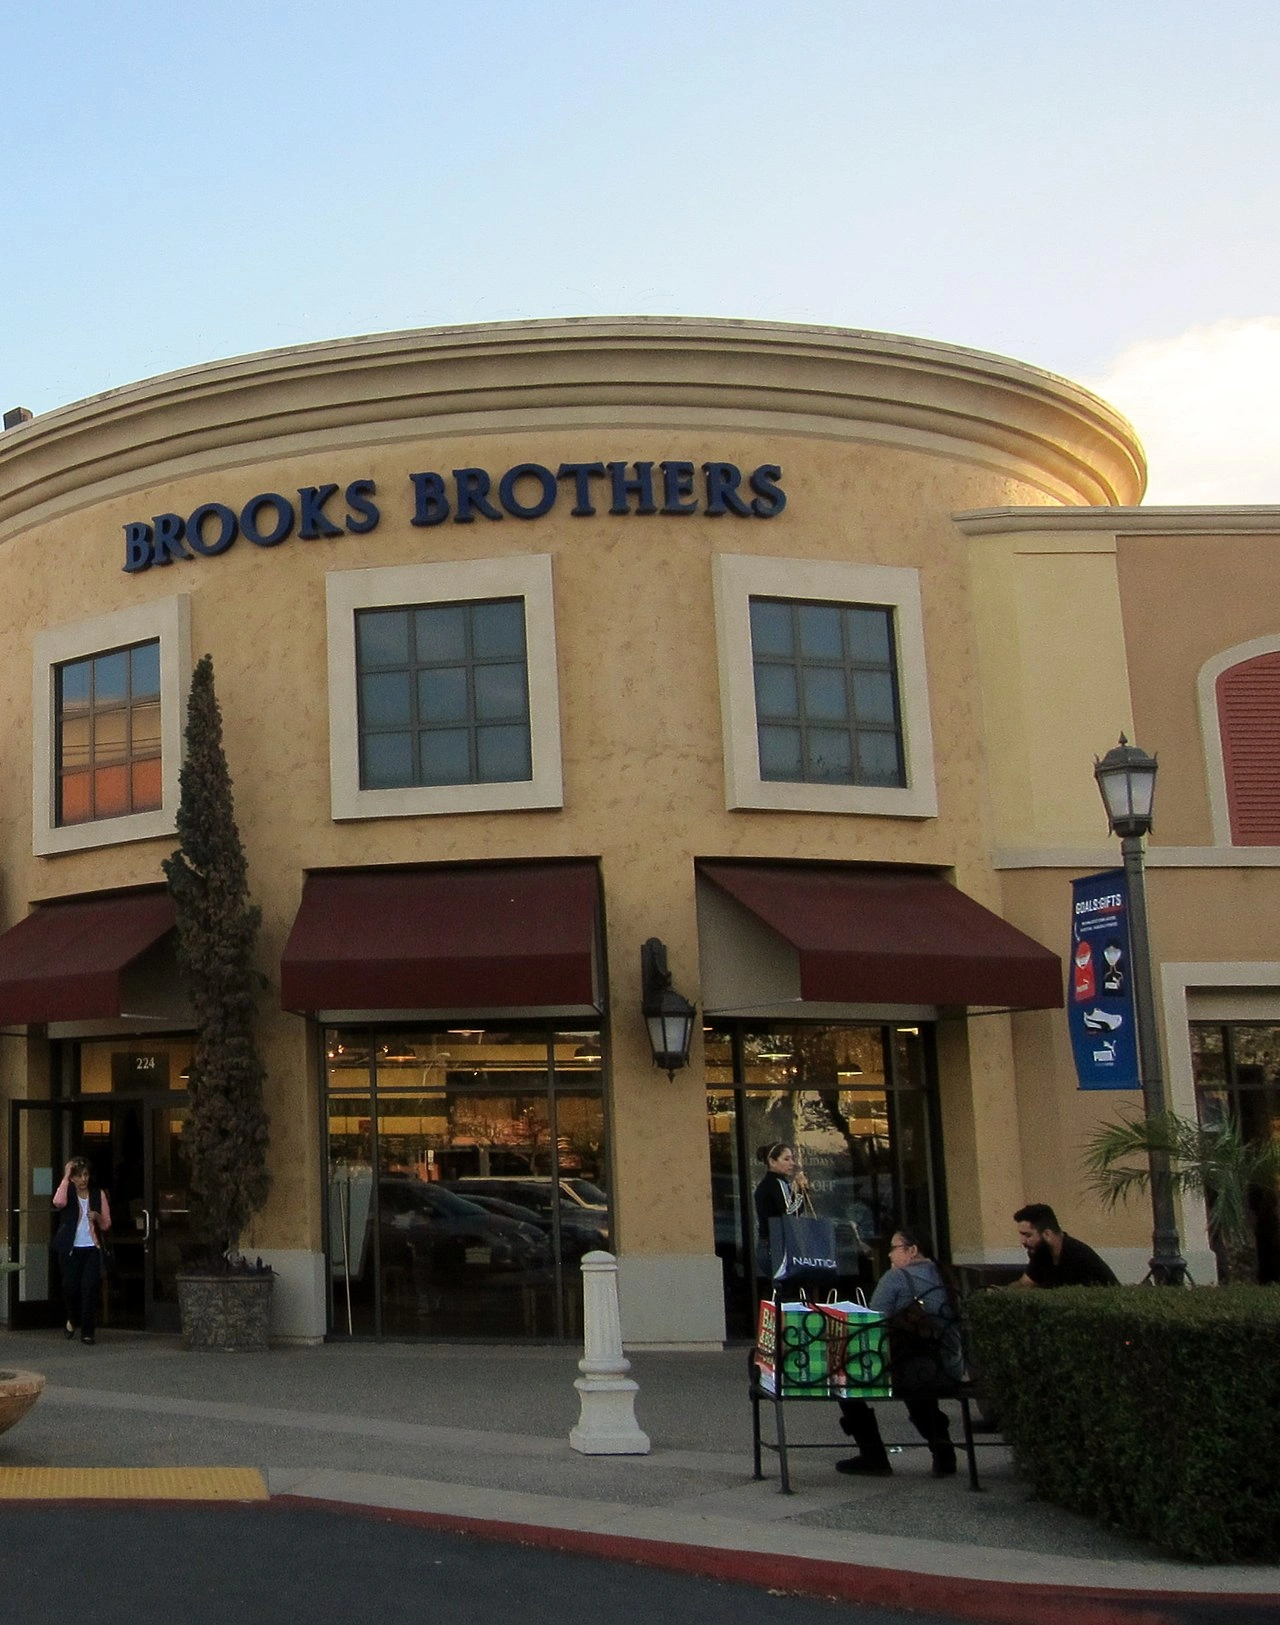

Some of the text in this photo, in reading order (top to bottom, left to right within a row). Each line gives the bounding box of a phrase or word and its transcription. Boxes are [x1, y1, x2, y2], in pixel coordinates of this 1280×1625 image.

[121, 460, 787, 574] BROOKS BROTHERS
[136, 1056, 155, 1070] 224
